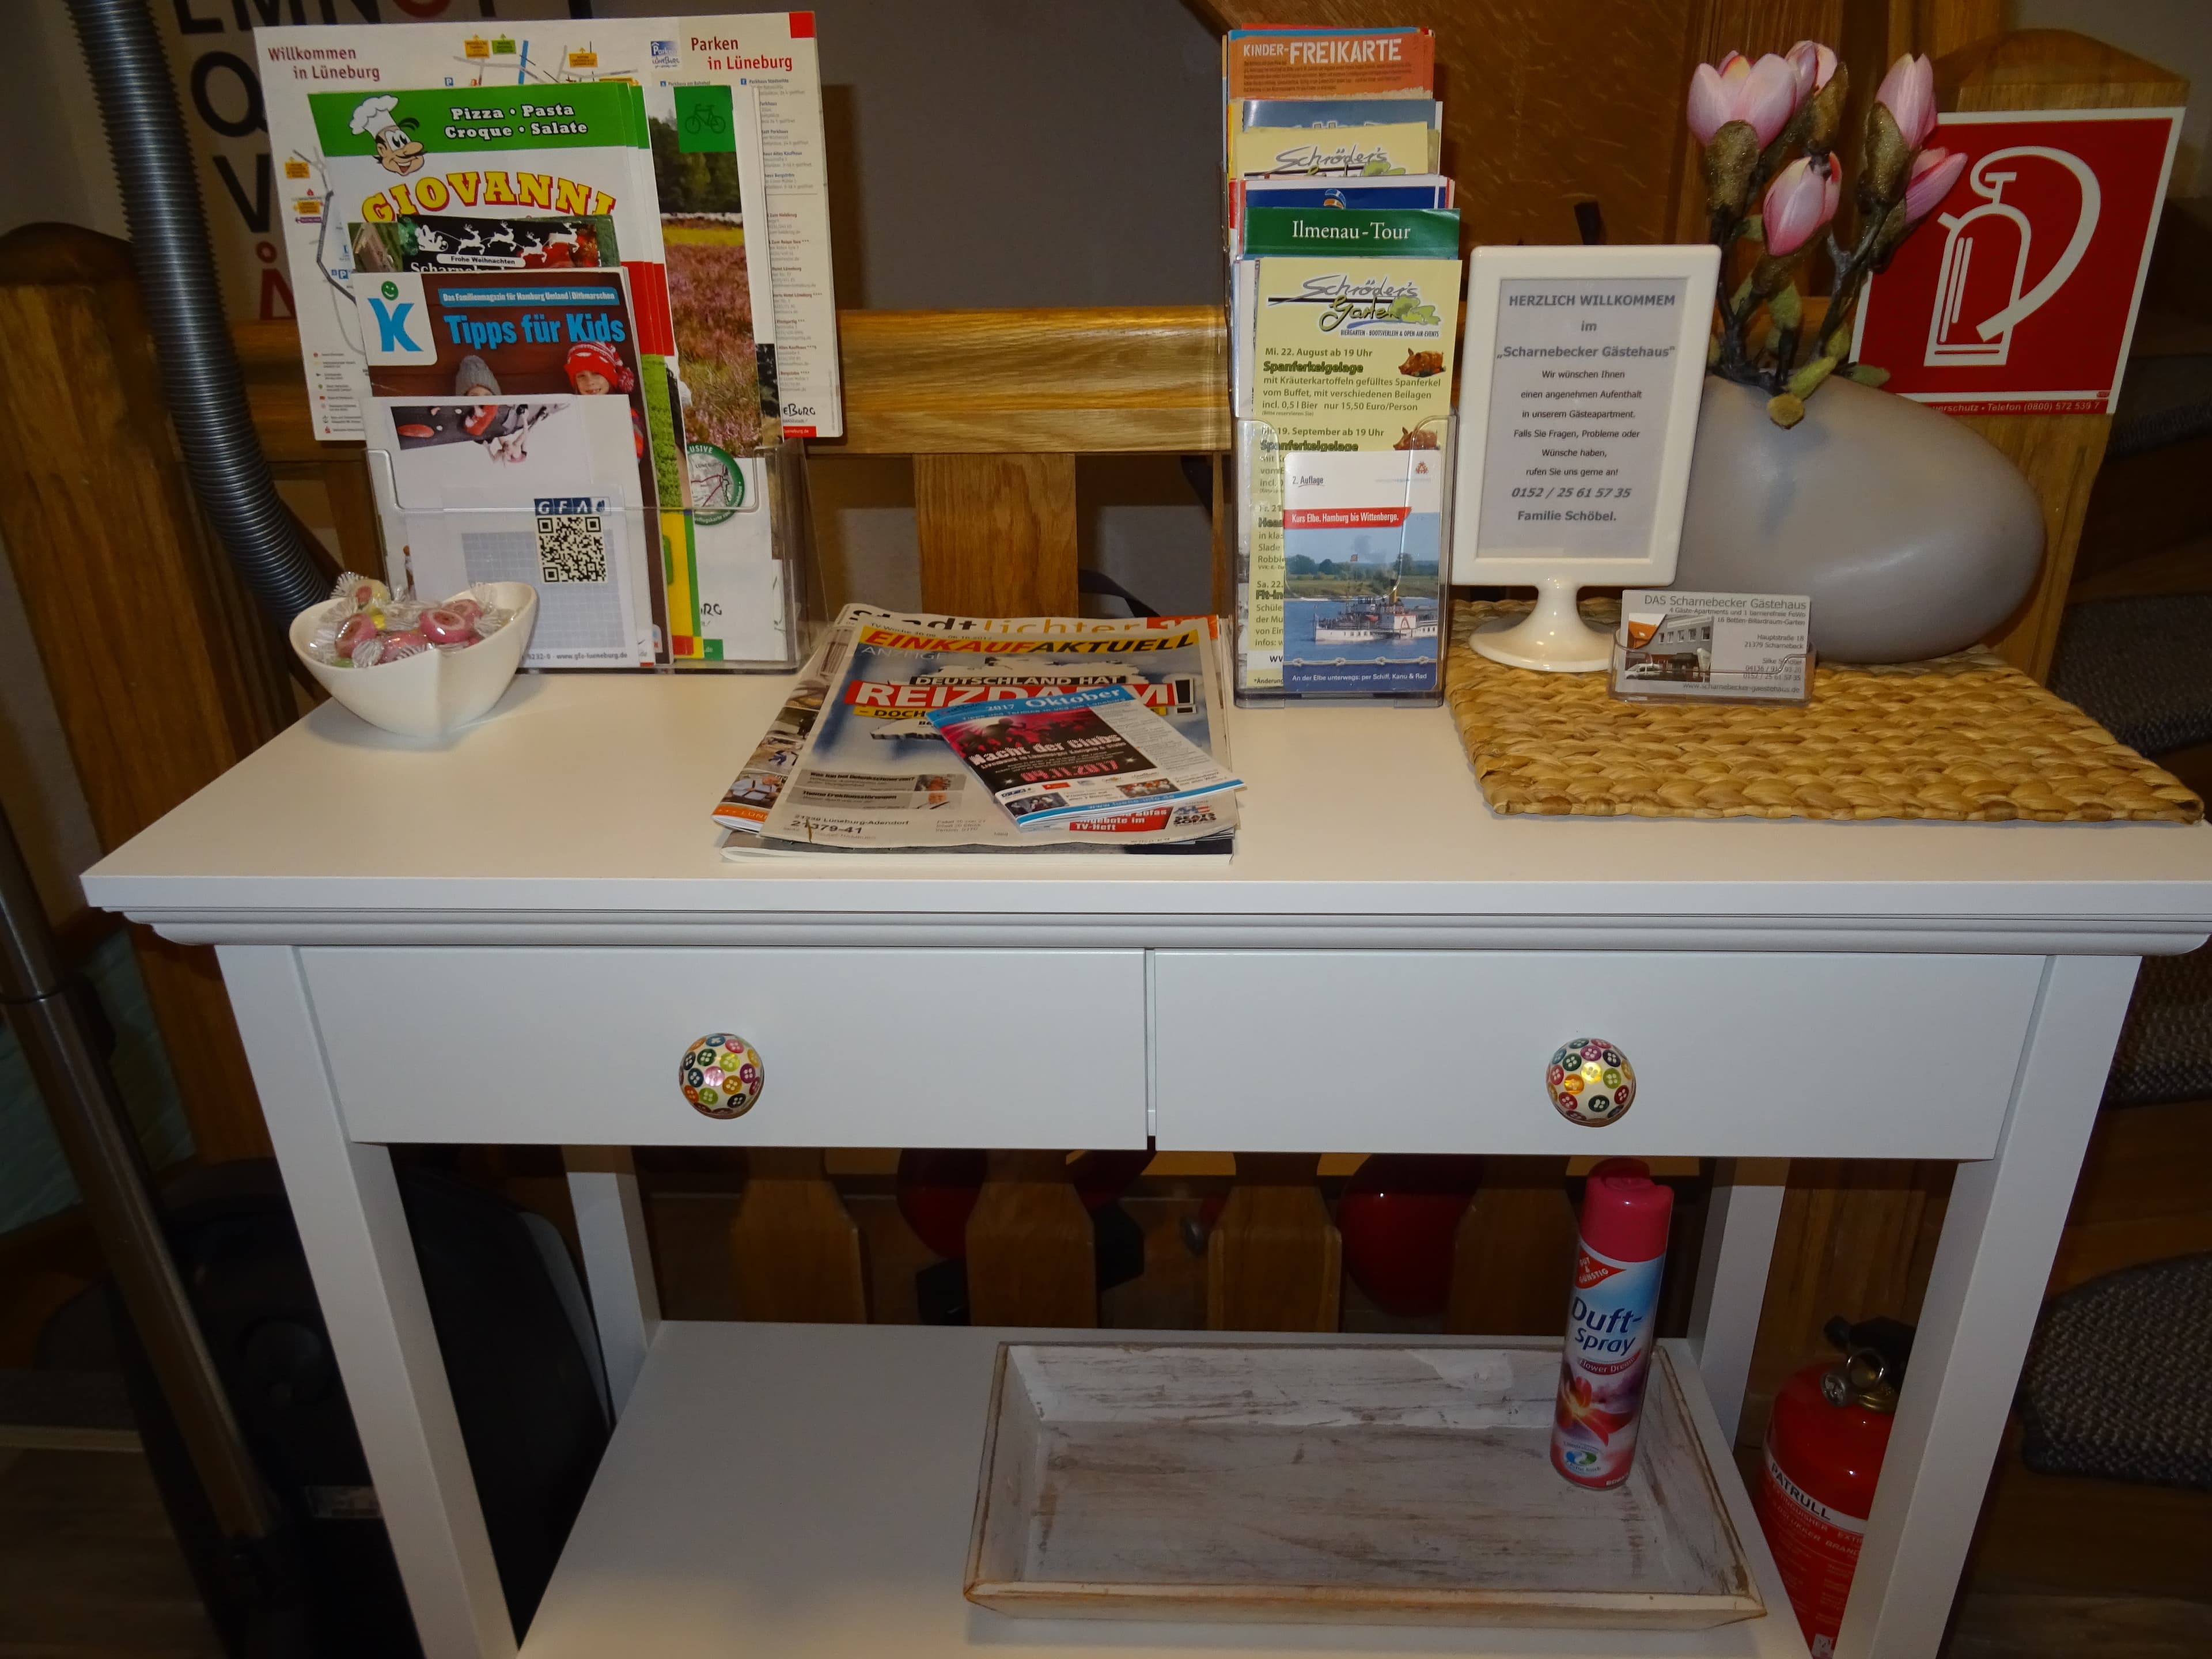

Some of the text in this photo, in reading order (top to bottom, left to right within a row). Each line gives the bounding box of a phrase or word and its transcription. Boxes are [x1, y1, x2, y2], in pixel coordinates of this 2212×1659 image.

[691, 36, 738, 51] Parken
[268, 47, 357, 61] Willkommen
[1244, 39, 1402, 64] KINDER-FREIKARTE
[707, 55, 793, 71] in Lüneburg
[293, 65, 380, 82] in Lüneburg
[191, 51, 267, 137] Q
[451, 104, 574, 121] Pizza Pasta
[444, 121, 588, 142] Croque Salate
[1273, 144, 1387, 170] Schröder's
[213, 153, 271, 233] V
[361, 171, 616, 223] GIOVANNI
[1283, 275, 1418, 301] Schröder's
[456, 293, 505, 302] Familienmagazin
[517, 292, 544, 301] Hamburg
[1509, 294, 1575, 306] HERZLICH
[368, 298, 424, 352] K
[444, 313, 626, 349] Tipps für Kids
[1581, 320, 1597, 332] im
[1265, 348, 1279, 356] Mi.
[1297, 349, 1328, 358] August
[1330, 349, 1341, 357] ab
[1357, 349, 1373, 357] Uhr
[1263, 361, 1363, 374] Spanferkelgelage
[1542, 370, 1625, 378] Wir wünschen Ihnen
[1280, 376, 1354, 385] Kräuterkartoffeln
[1356, 378, 1393, 387] gefülltes
[1395, 378, 1441, 387] Spanferkel
[1284, 389, 1312, 397] Buffet,
[1314, 389, 1328, 397] mit
[1331, 389, 1392, 398] verschiedenen
[1395, 391, 1431, 400] Beilagen
[1546, 391, 1597, 400] angenehmen
[1600, 390, 1642, 398] Aufenthalt
[1282, 401, 1294, 410] 0,5
[1301, 401, 1317, 409] Bier
[1342, 402, 1364, 411] 15,50
[1366, 402, 1418, 411] Euro/Person
[2024, 402, 2052, 412] (0800)
[2055, 402, 2072, 410] 572
[1522, 410, 1530, 418] in
[1532, 410, 1567, 418] unserem
[1292, 427, 1340, 437] September
[1342, 428, 1353, 436] ab
[1355, 428, 1366, 436] 19
[1368, 428, 1385, 436] Uhr
[1513, 429, 1641, 440] Falls Sie Fragen, Probleme oder
[1541, 449, 1607, 458] Wünsche haben,
[1525, 467, 1547, 476] rufen
[1549, 468, 1561, 476] Sie
[1605, 468, 1618, 476] an!
[1292, 475, 1324, 485] 2. Auflage
[1511, 487, 1633, 499] 0152 / 25 61 57 35
[1292, 512, 1399, 524] Kurs Elbe. Hamburg bis Wittenberge.
[1517, 510, 1617, 521] Familie Schöbel.
[1645, 595, 1806, 609] DAS Scharnebecker Gästehaus
[915, 675, 1123, 685] DEUTSCHLAND HAT
[1025, 688, 1120, 709] Oktober
[874, 709, 925, 719] DOCH
[1033, 743, 1065, 753] der
[1067, 734, 1122, 749] Clubs
[1572, 1296, 1642, 1334] Duft-
[1611, 1357, 1636, 1372] Dream
[1771, 1463, 1831, 1521] PATRULL
